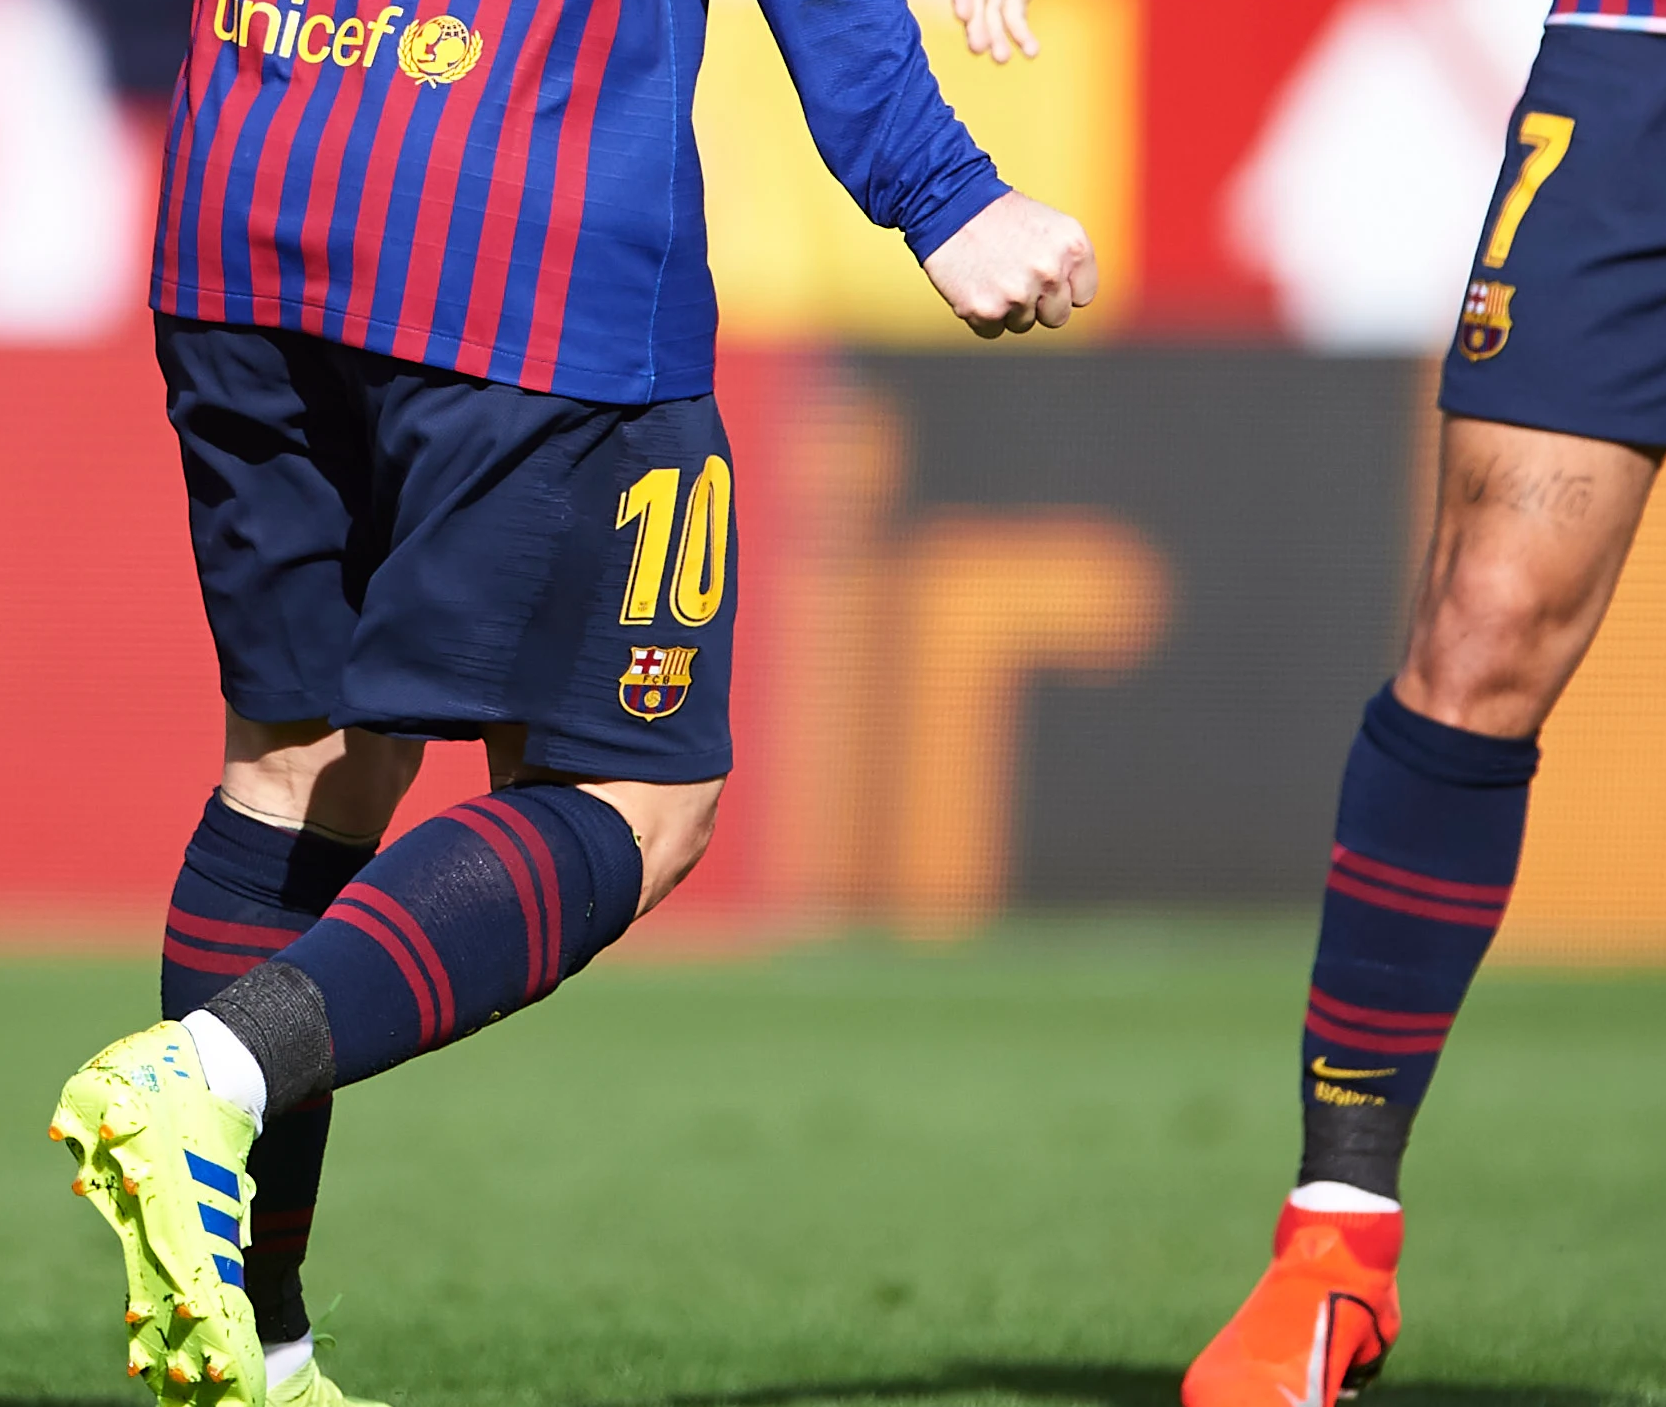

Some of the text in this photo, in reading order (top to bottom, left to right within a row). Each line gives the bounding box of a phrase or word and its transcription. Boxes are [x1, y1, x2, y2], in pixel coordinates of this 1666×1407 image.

[1482, 110, 1576, 270] 7
[615, 454, 731, 627] 10
[642, 674, 671, 686] FCB
